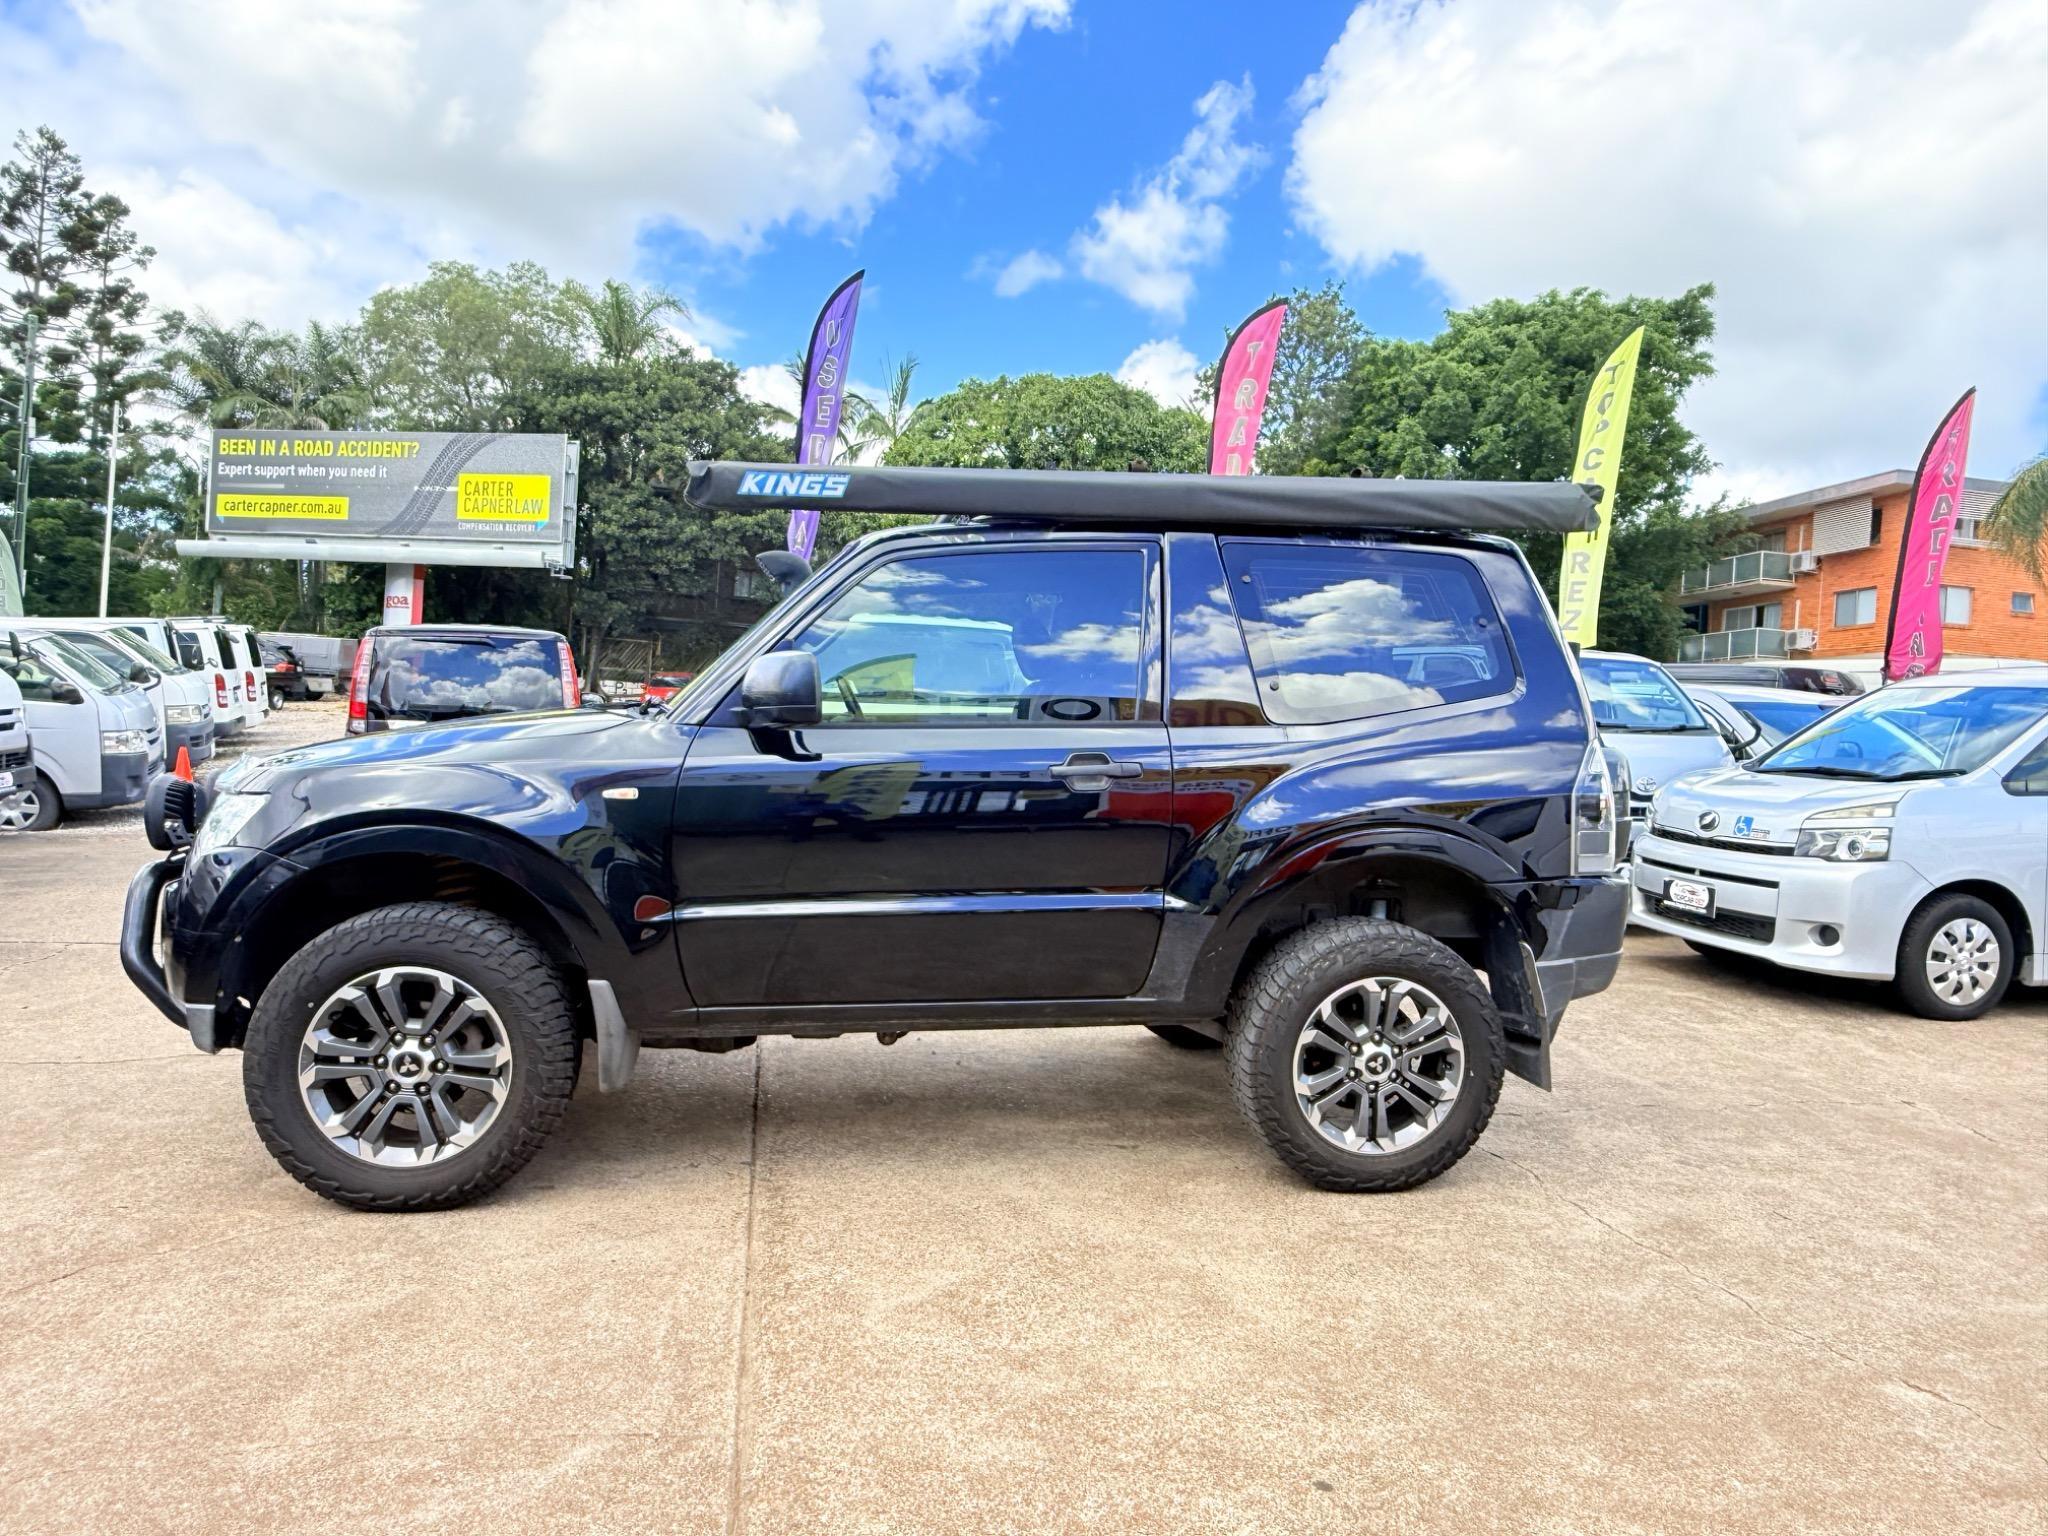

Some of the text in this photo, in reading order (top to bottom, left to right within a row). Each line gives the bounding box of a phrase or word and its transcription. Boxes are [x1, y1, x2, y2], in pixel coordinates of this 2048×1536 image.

[1226, 341, 1264, 475] TRAD
[219, 439, 420, 458] BEEN IN A ROAD ACCIDENT?
[218, 462, 387, 480] Expert support when you need it
[464, 480, 514, 497] CARTER
[738, 472, 850, 497] KINGS
[223, 500, 342, 516] cartercapner.com.au
